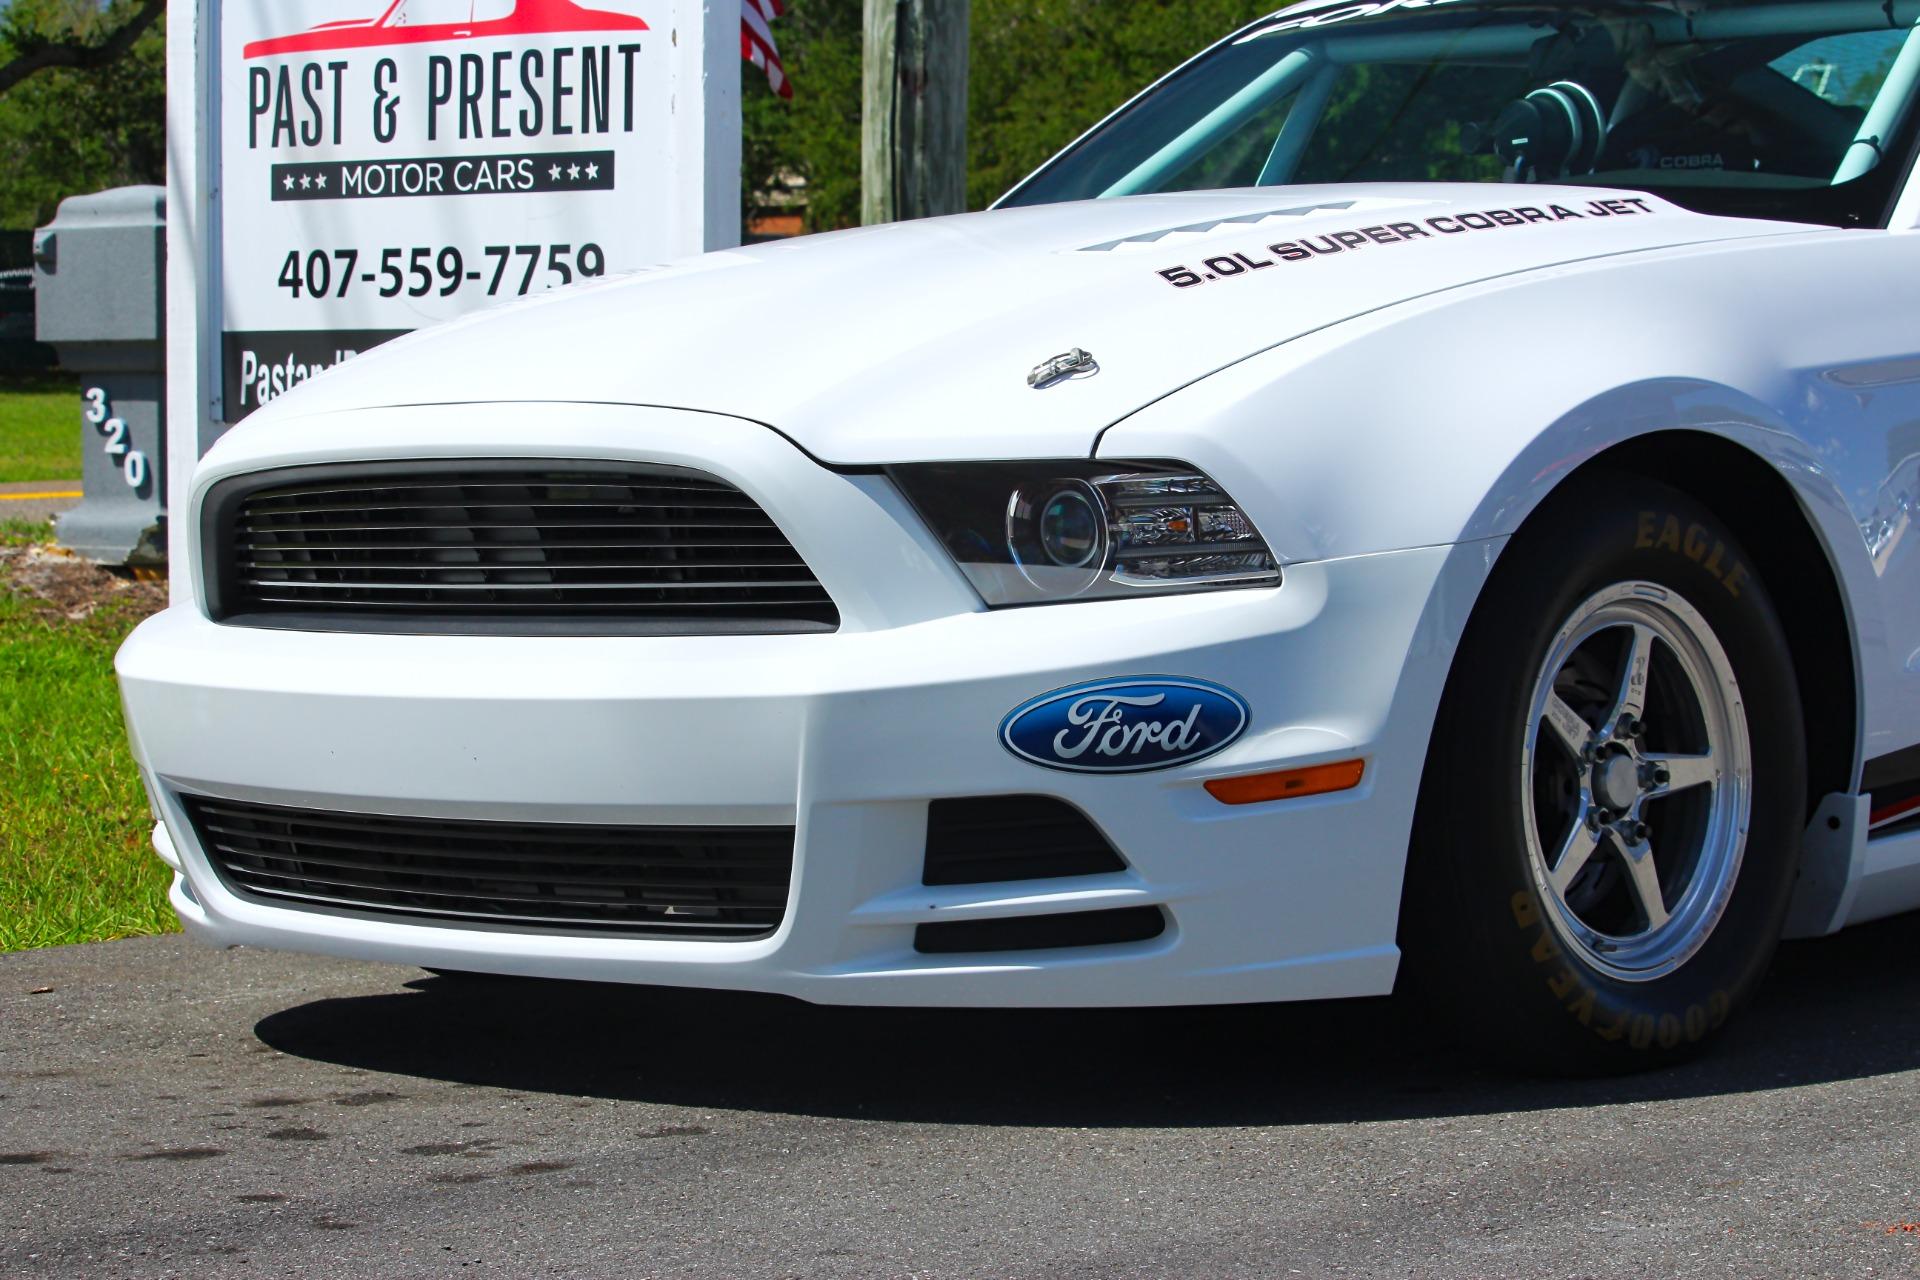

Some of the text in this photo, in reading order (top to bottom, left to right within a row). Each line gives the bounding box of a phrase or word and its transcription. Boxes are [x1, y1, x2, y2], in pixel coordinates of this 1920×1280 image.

[249, 43, 641, 149] PAST & PRESENT
[342, 160, 534, 195] MOTOR CARS
[1660, 153, 1724, 168] COBRA
[278, 243, 605, 298] 407-559-7759
[1157, 197, 1657, 288] 5.0L SUPER COBRA JET
[86, 387, 145, 487] 320
[1634, 511, 1750, 598] EAGLE
[1053, 693, 1202, 759] Ford
